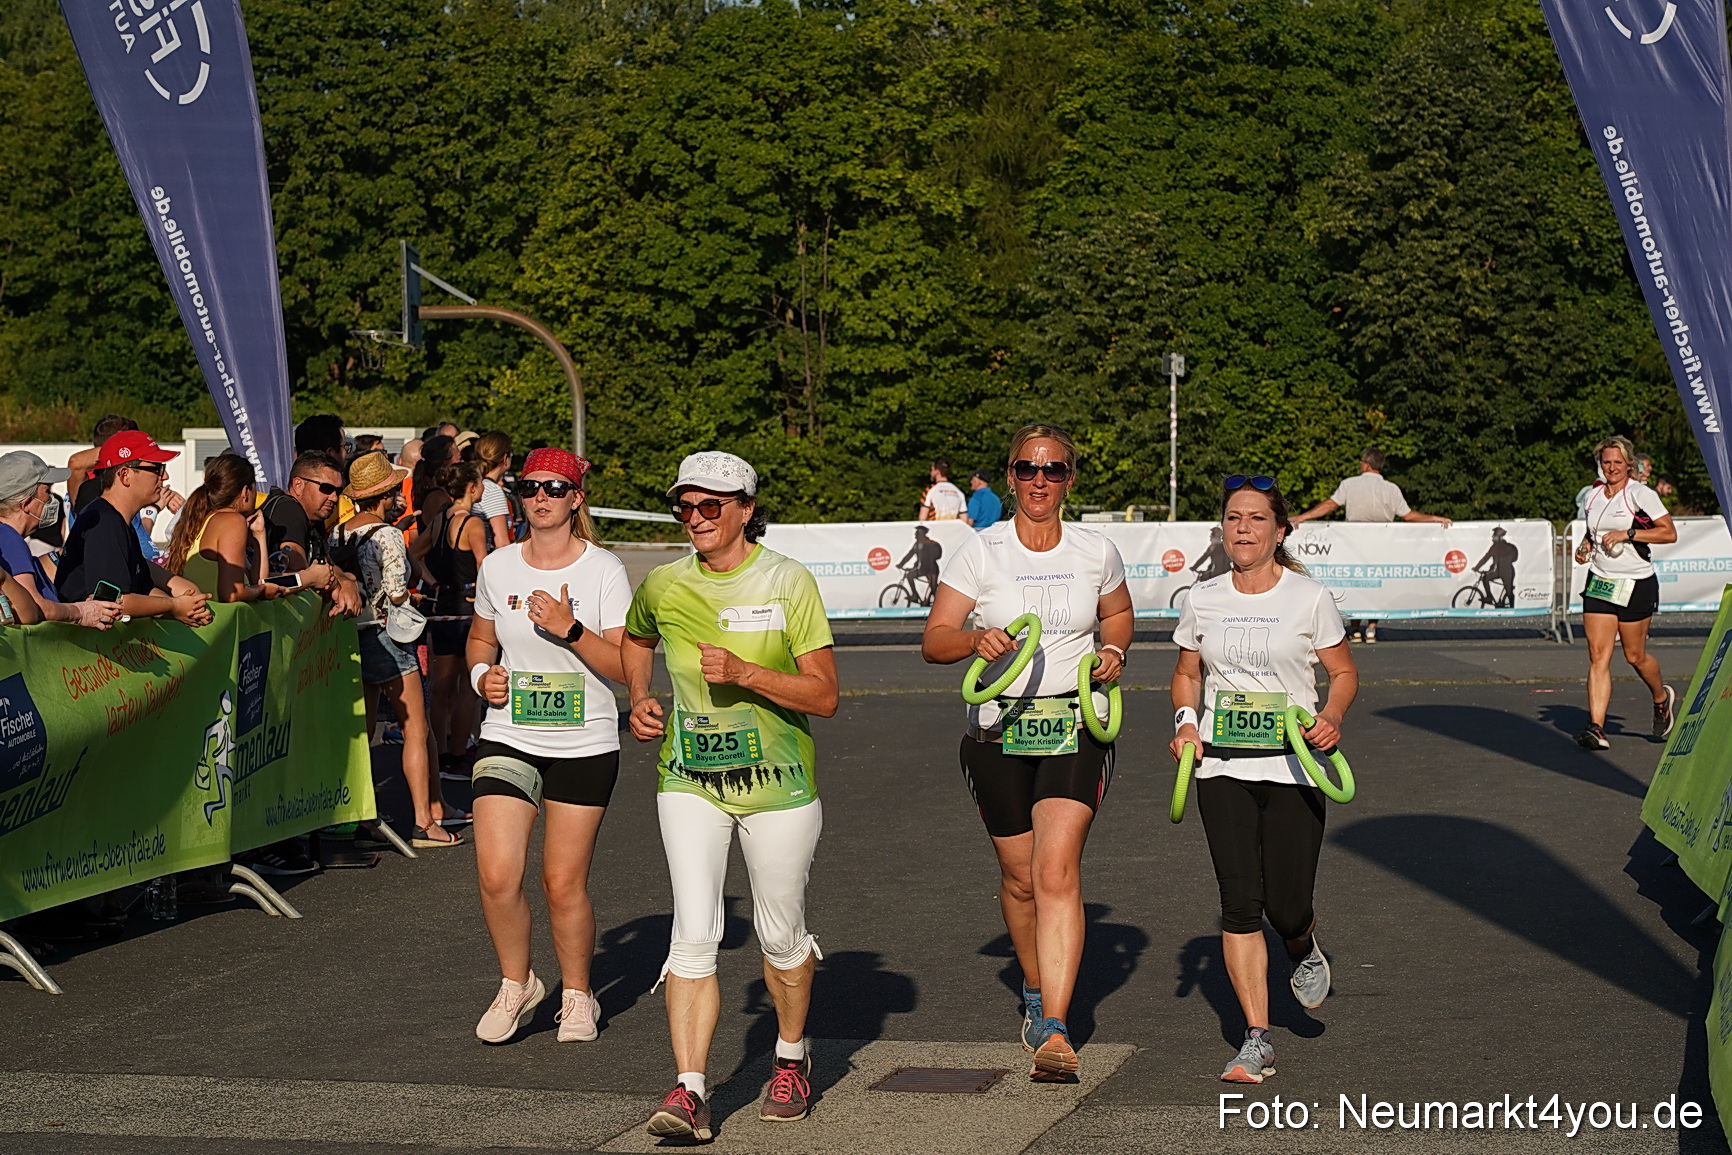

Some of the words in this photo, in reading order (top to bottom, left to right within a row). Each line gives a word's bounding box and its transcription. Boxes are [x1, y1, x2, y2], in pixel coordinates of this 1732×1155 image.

[1298, 544, 1332, 556] NOW
[1015, 572, 1075, 582] ZAHNARZTPRAXIS
[1353, 565, 1364, 577] &
[1367, 563, 1446, 577] FAHRRÄDER
[1594, 580, 1616, 593] 1952
[62, 644, 120, 700] Gesunde
[242, 664, 263, 687] Fischer
[529, 691, 566, 709] 178
[573, 693, 581, 719] 2022
[526, 709, 542, 717] Bald
[1225, 710, 1275, 730] 1505
[0, 710, 35, 739] Fischer
[1014, 718, 1065, 737] 1504
[1216, 715, 1224, 736] RUN
[1276, 715, 1284, 741] 2022
[7, 729, 37, 749] AUTOMOBILE
[696, 731, 739, 753] 925
[746, 731, 759, 759] 2022
[1014, 738, 1036, 747] Meyer
[1037, 738, 1065, 746] Kristina
[1246, 731, 1270, 739] Judith
[683, 738, 693, 759] RUN
[695, 753, 717, 763] Bayer
[717, 750, 746, 761] Goretti
[0, 746, 89, 837] enlauf
